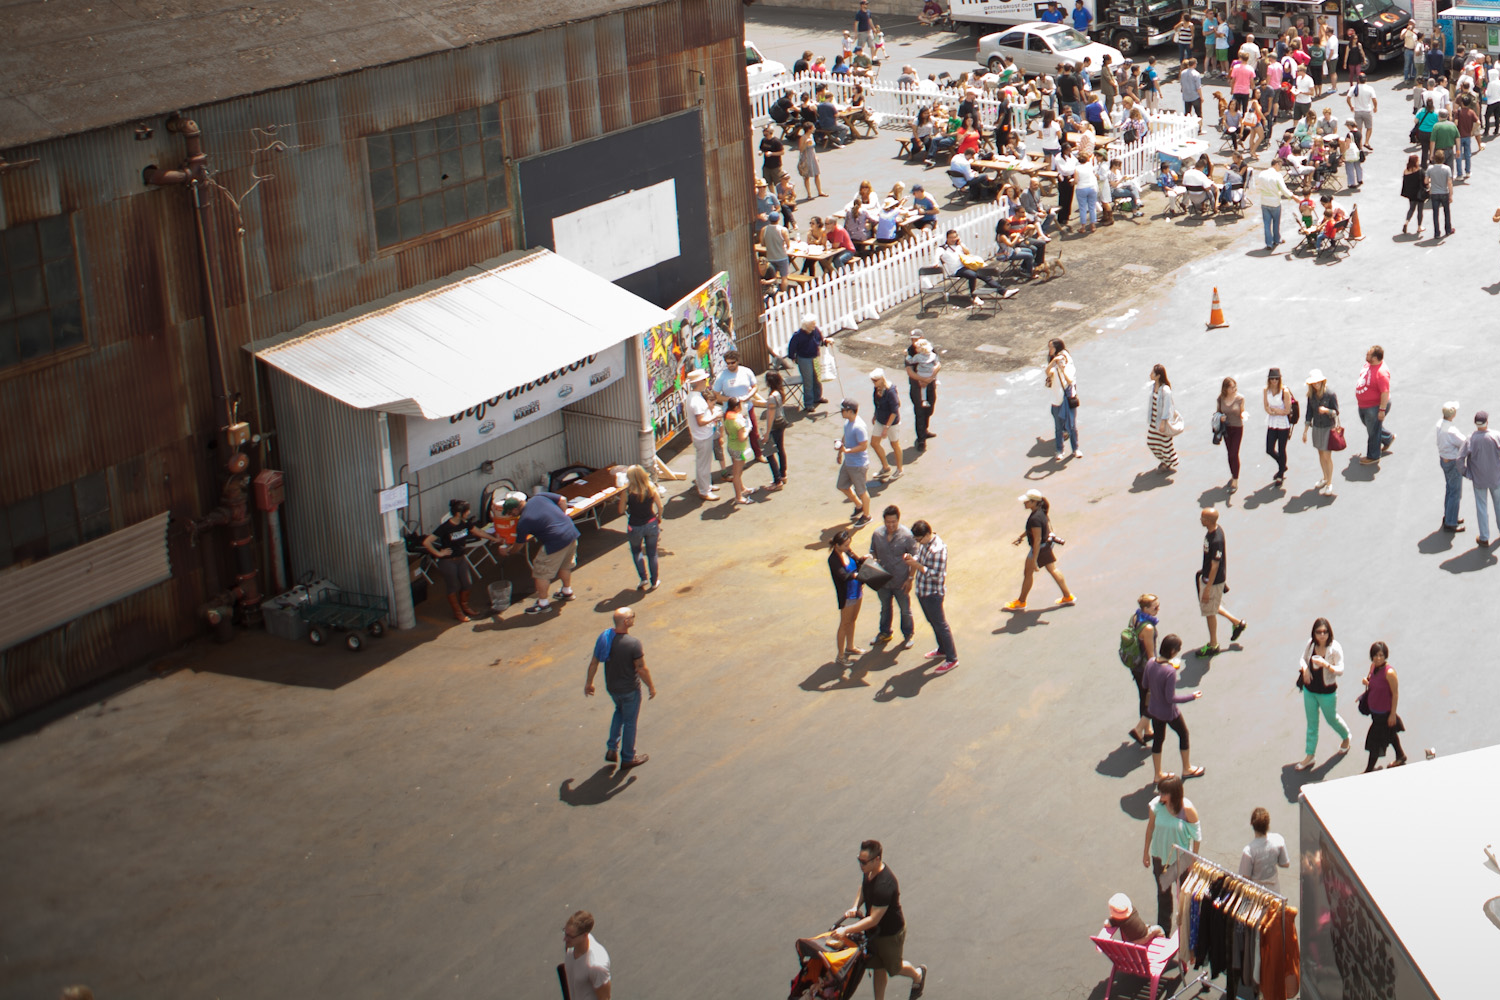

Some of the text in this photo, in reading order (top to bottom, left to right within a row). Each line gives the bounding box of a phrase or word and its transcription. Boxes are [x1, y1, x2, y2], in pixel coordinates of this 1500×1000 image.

[1193, 0, 1205, 7] FOOD
[513, 405, 541, 421] MARKET
[429, 439, 461, 456] MARKET
